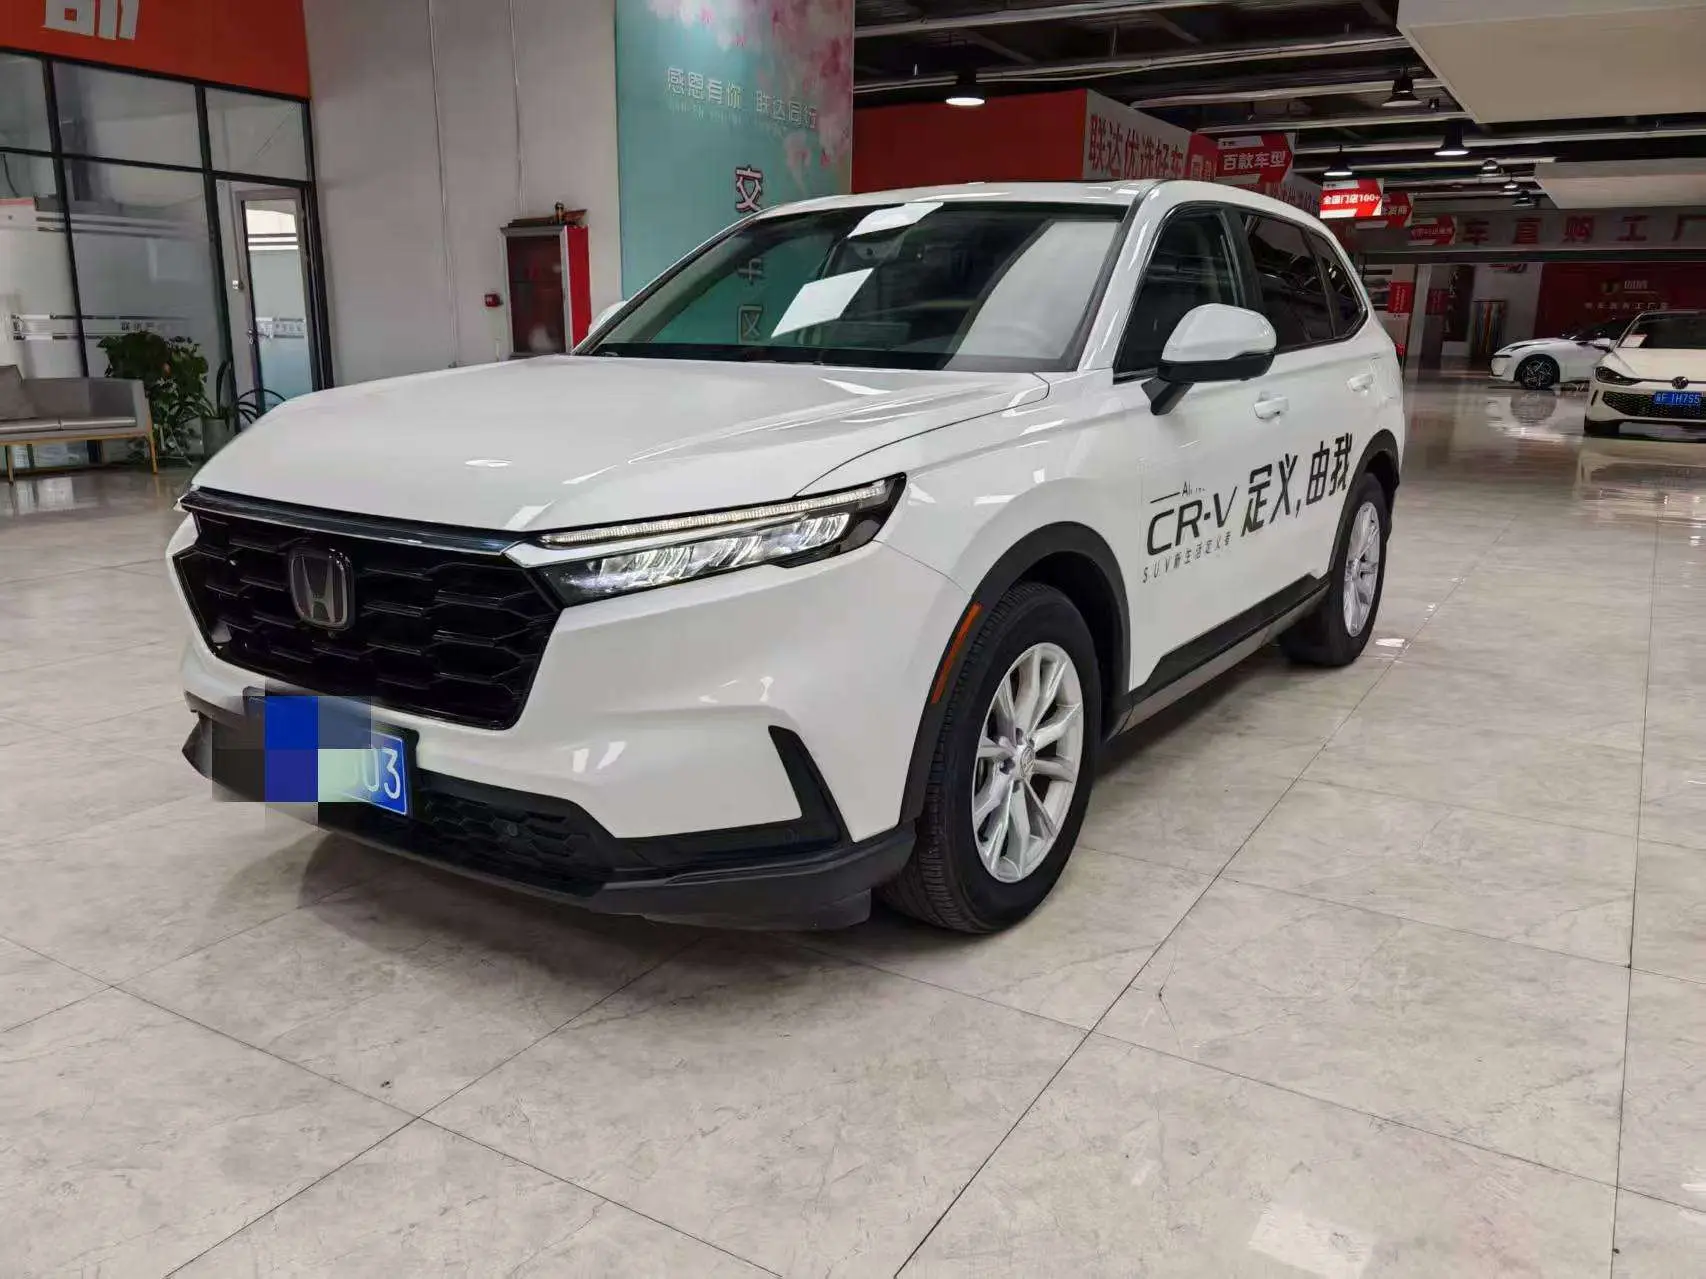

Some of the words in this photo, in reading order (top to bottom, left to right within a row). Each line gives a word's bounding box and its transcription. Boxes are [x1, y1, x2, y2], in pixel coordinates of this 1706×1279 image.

[1223, 151, 1286, 171] 百款车型
[1147, 486, 1238, 556] CR-V
